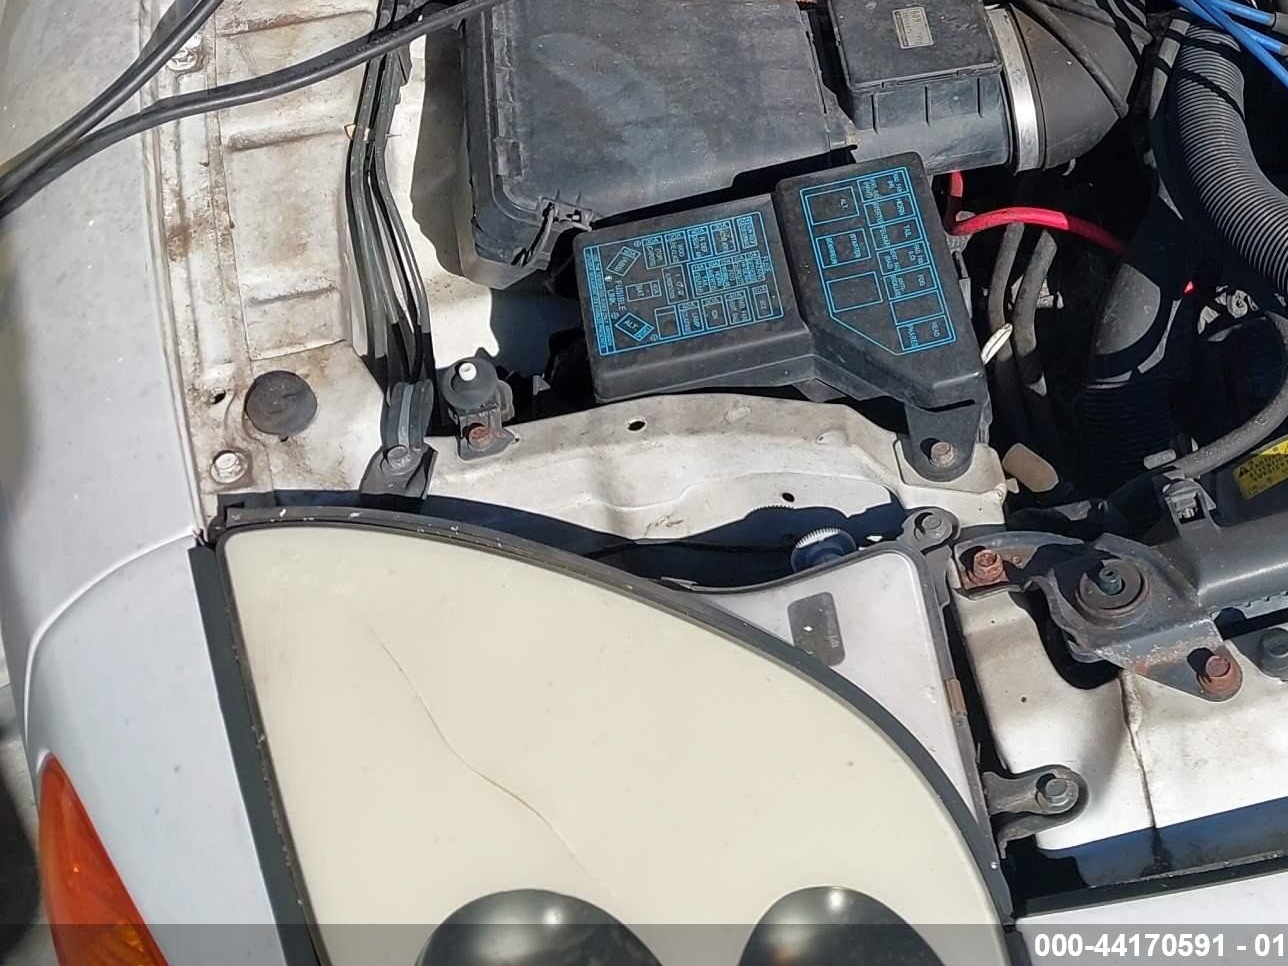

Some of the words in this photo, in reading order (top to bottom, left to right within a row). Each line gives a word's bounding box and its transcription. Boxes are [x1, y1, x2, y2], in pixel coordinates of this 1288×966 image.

[895, 198, 905, 215] HORN
[606, 288, 616, 305] LINK
[612, 279, 628, 311] FUSIBLE
[930, 321, 940, 337] HEAD
